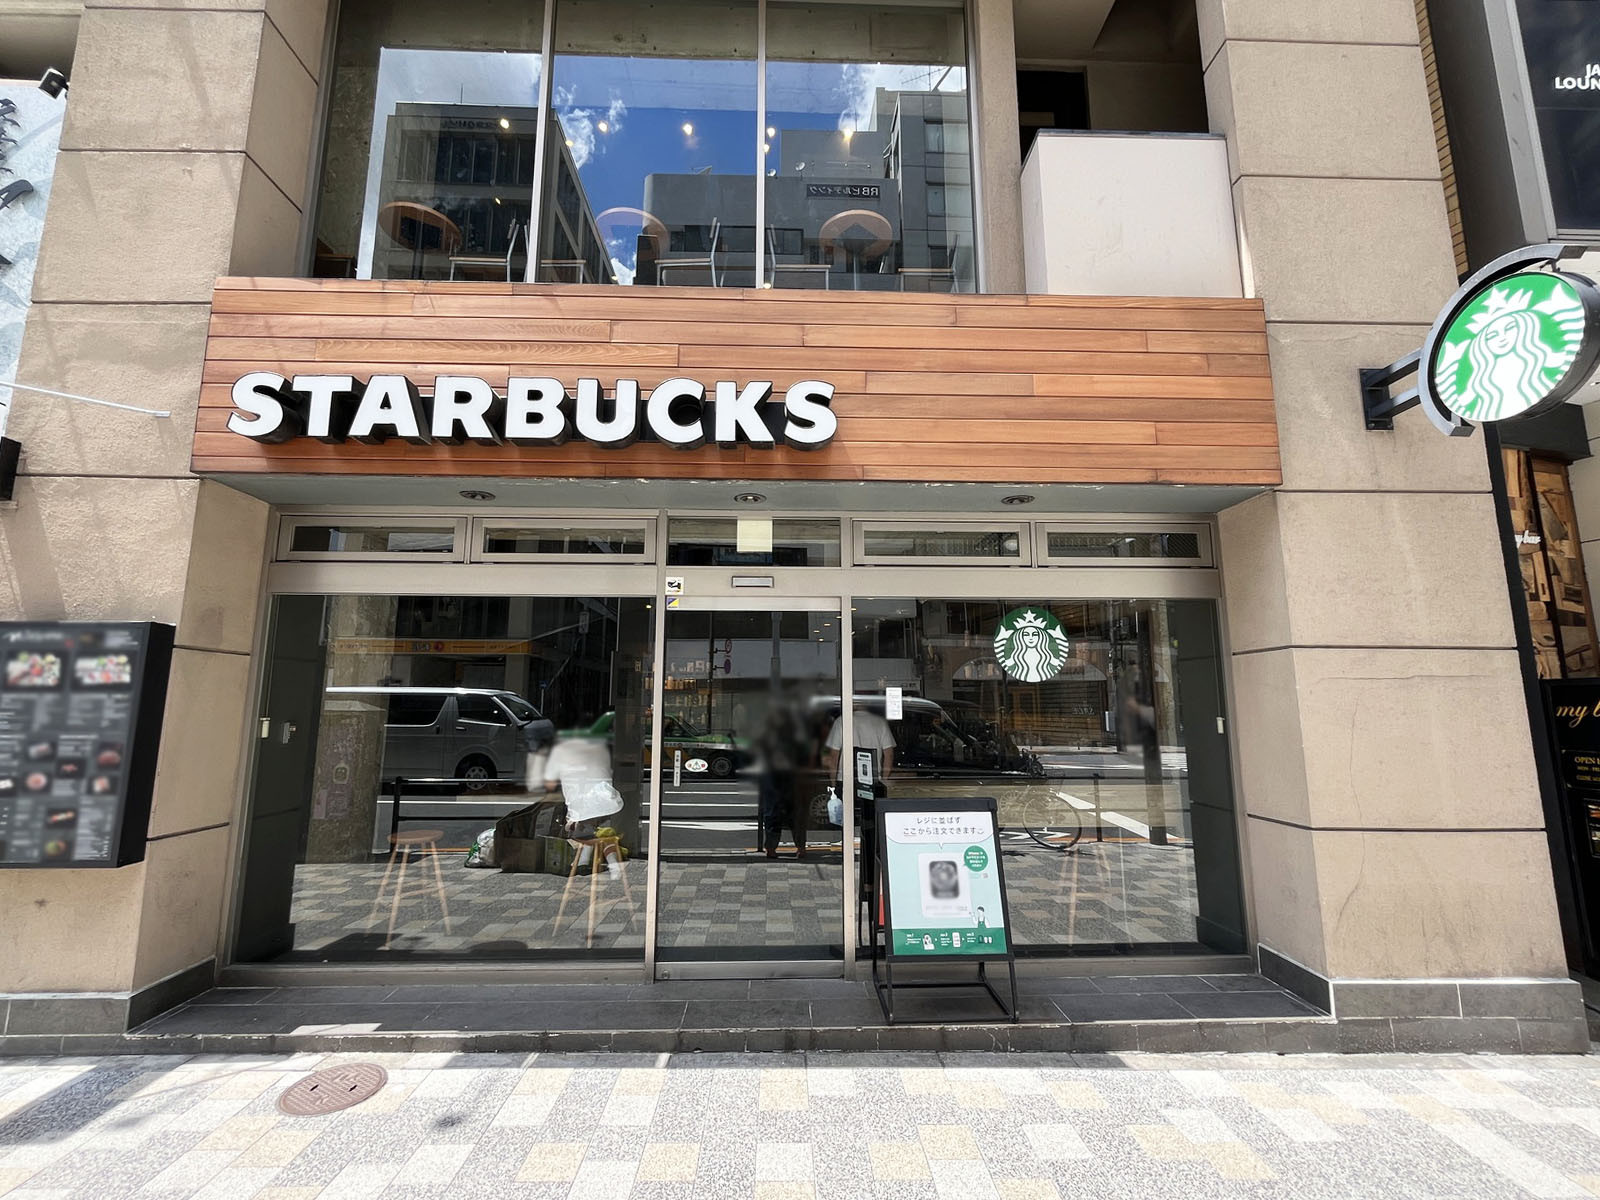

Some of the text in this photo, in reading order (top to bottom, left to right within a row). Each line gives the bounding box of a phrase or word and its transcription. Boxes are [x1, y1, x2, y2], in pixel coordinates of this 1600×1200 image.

[1554, 76, 1600, 90] LOUN
[226, 371, 838, 446] STARBUCKS
[1556, 705, 1589, 728] my
[1574, 756, 1596, 765] OPEN
[916, 816, 961, 825] レジに並ばず
[903, 827, 977, 836] ここから注文できます
